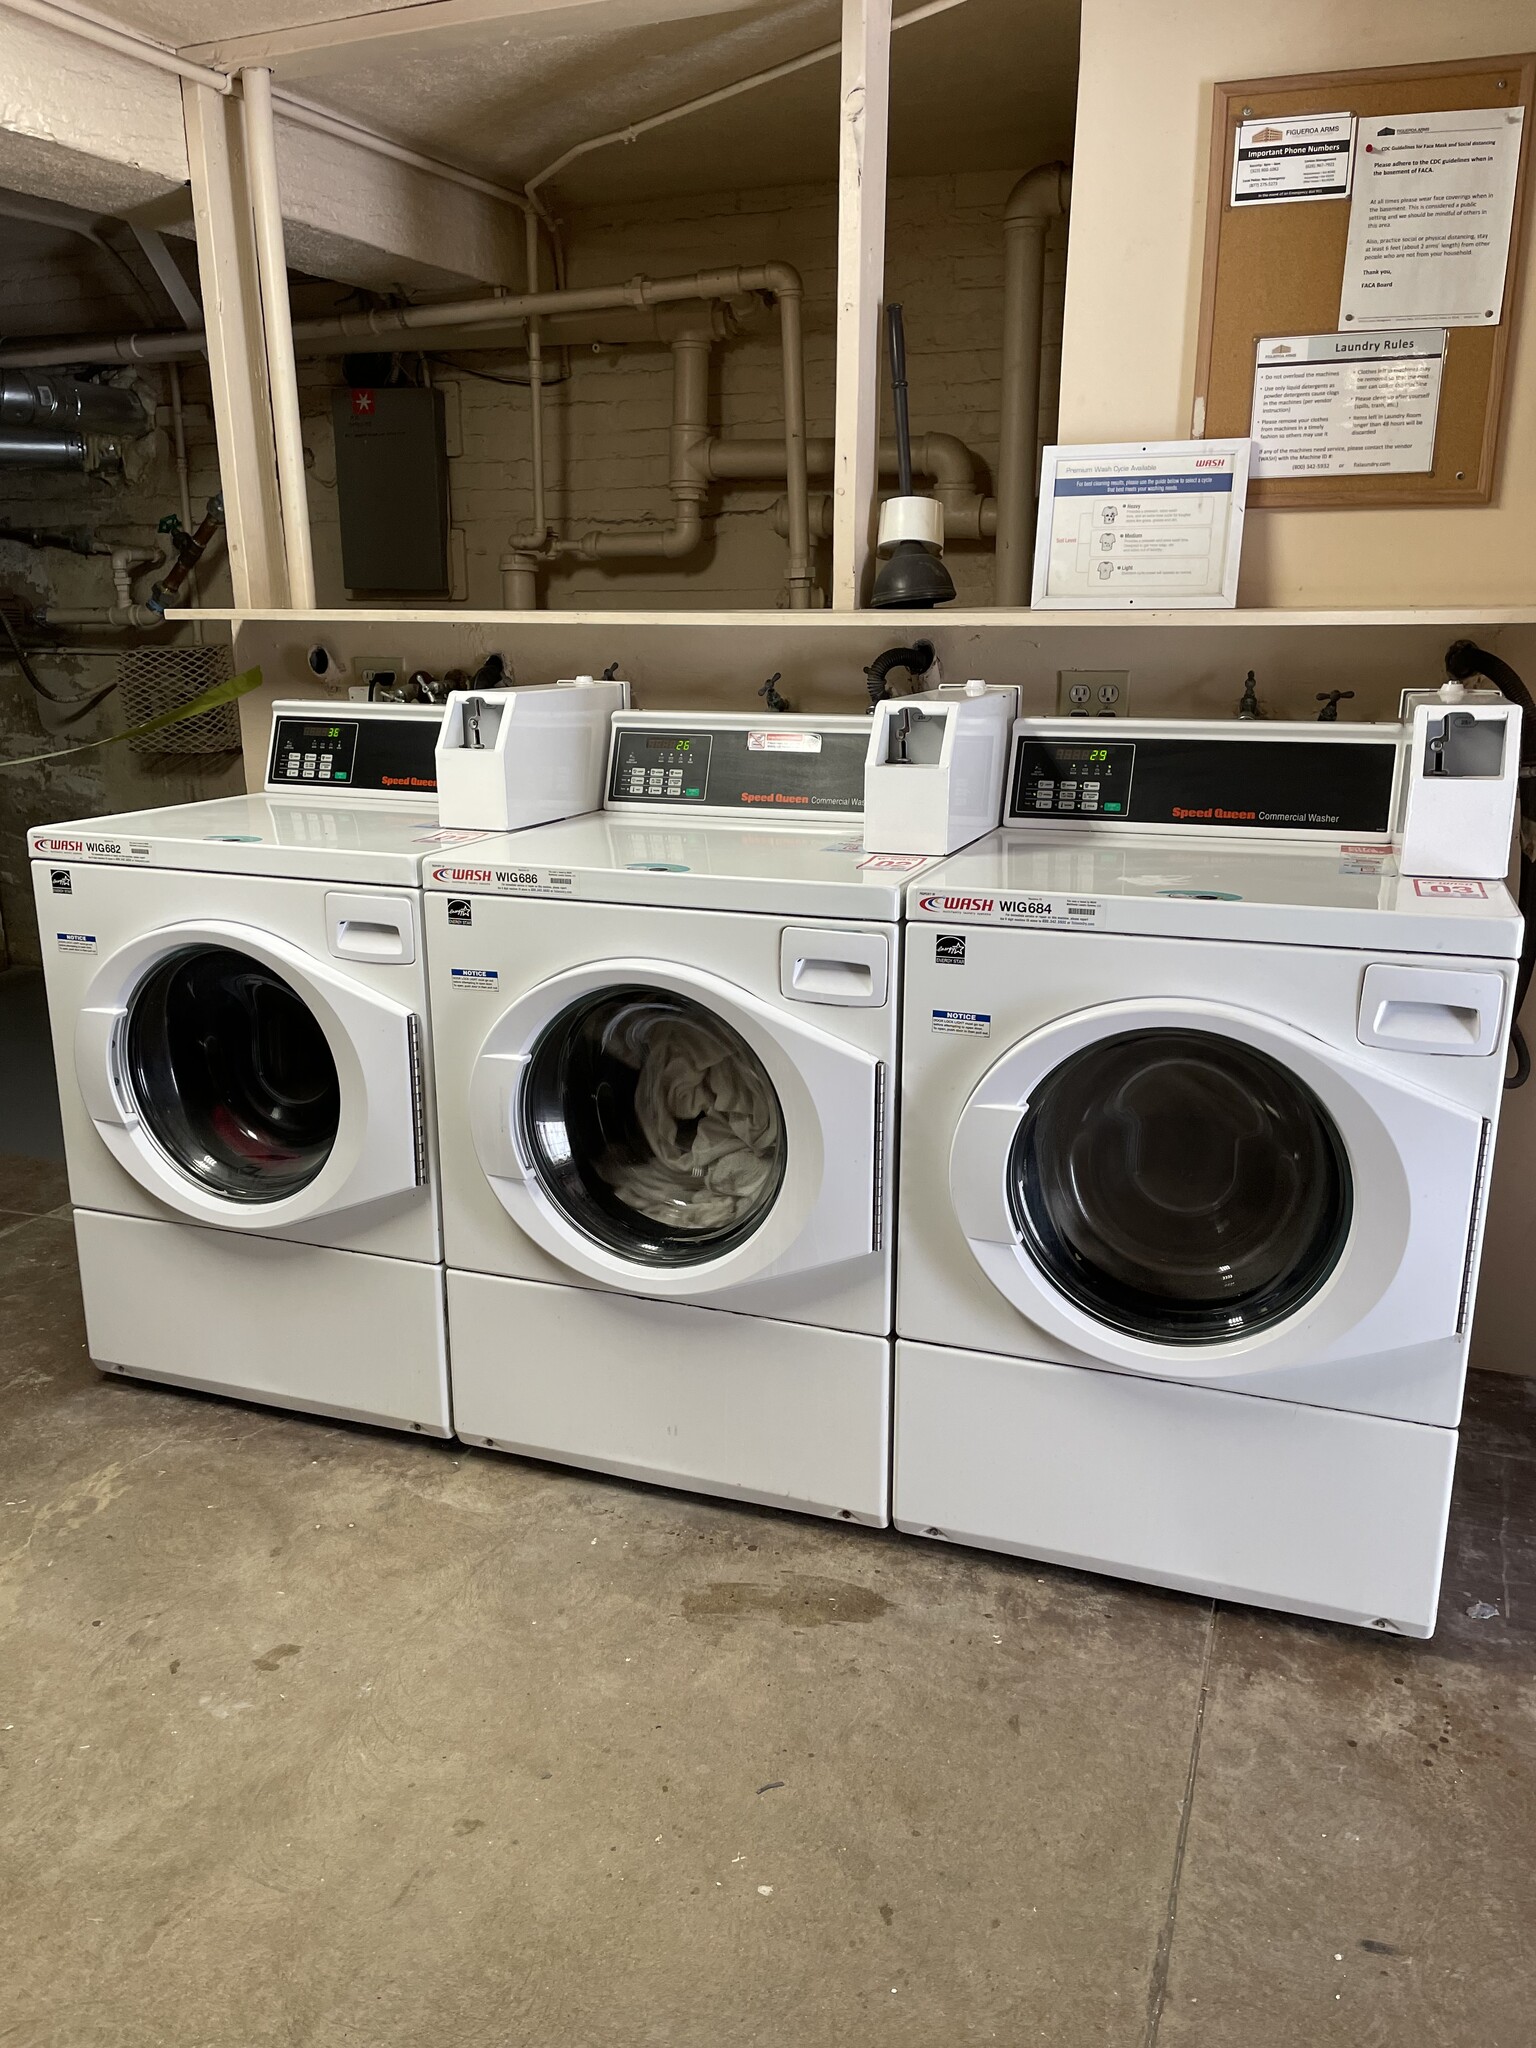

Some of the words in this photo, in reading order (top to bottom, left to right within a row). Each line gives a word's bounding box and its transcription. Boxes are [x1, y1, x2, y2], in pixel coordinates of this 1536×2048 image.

[1248, 148, 1282, 158] Important
[1285, 146, 1306, 154] Phone
[1308, 144, 1339, 152] Numbers
[1336, 341, 1380, 352] Laundry
[1384, 339, 1414, 350] Rules
[1196, 459, 1225, 467] WASH
[328, 728, 339, 737] 36
[676, 741, 690, 750] 26
[1090, 750, 1107, 761] 29
[382, 776, 410, 786] Speed
[741, 792, 773, 803] Speed
[776, 794, 808, 804] Queen
[811, 796, 849, 805] Commercial
[1172, 807, 1212, 819] Speed
[1214, 808, 1255, 820] Queen
[1258, 811, 1306, 822] Commercial
[1308, 813, 1339, 823] Washer
[51, 839, 83, 852] WASH
[86, 843, 121, 854] WIG682
[452, 868, 491, 882] WASH
[496, 872, 538, 884] WIG686
[1430, 886, 1474, 894] 03
[944, 897, 994, 912] WASH
[1000, 901, 1052, 914] WIG684
[947, 1012, 976, 1021] NOTICE
